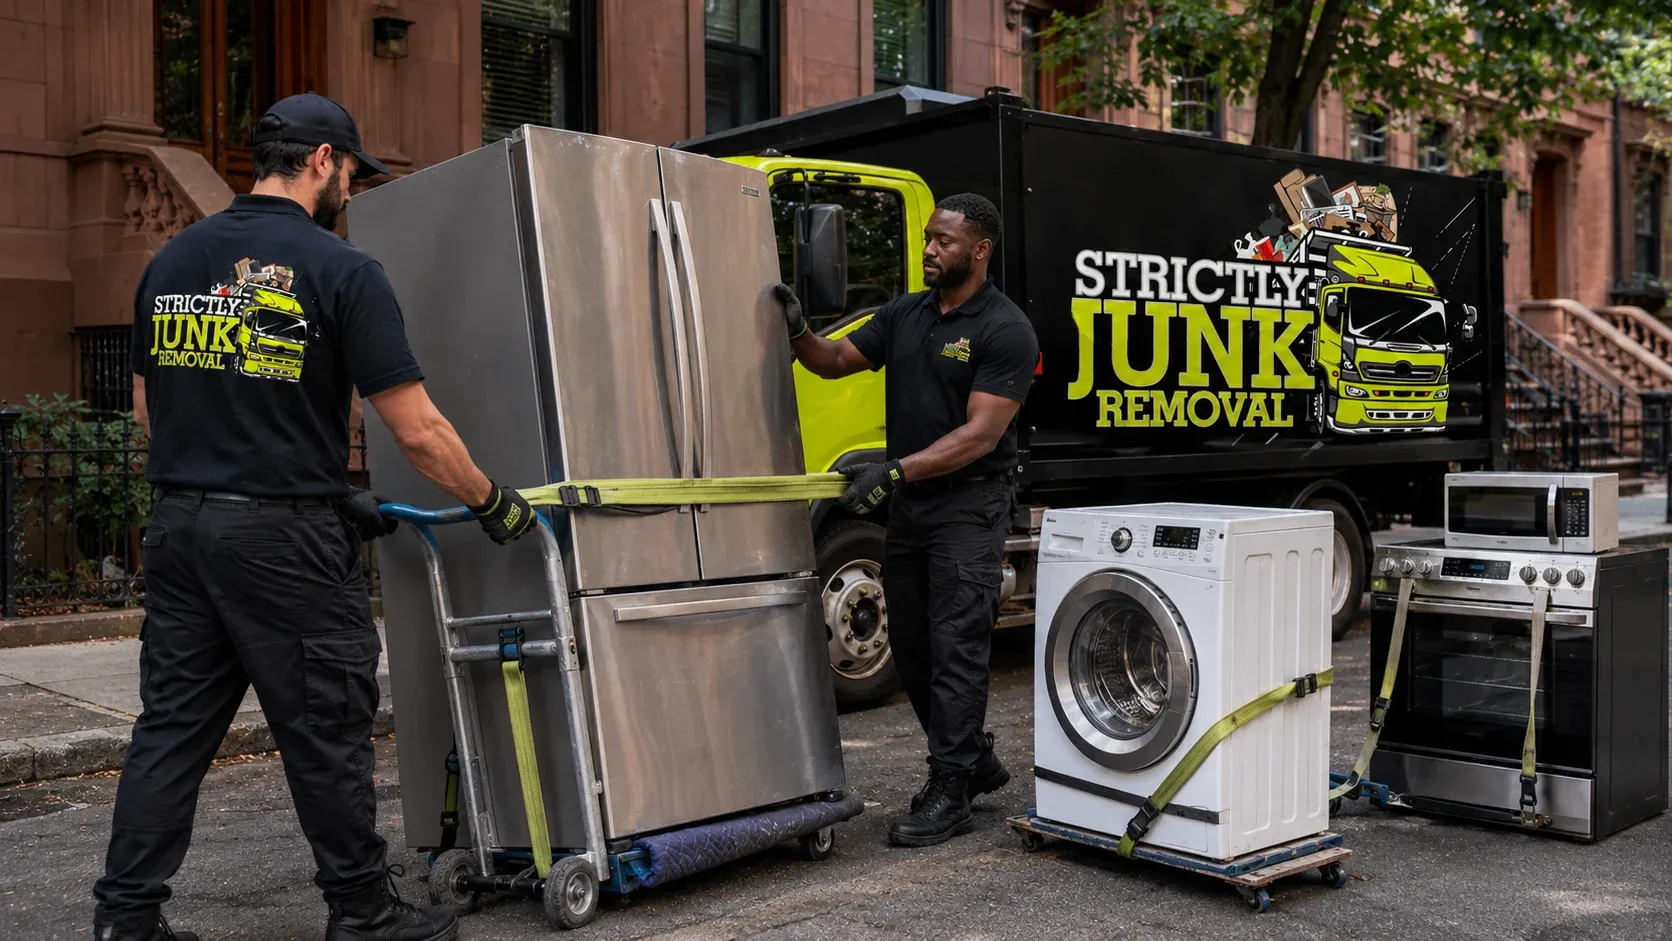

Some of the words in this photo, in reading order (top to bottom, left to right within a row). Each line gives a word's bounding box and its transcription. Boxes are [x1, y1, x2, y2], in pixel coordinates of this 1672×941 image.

[1075, 249, 1309, 308] STRICTLY
[154, 295, 241, 315] STRICTLY
[151, 314, 240, 355] JUNK
[1068, 298, 1315, 400] JUNK
[158, 351, 225, 370] REMOVAL
[1096, 391, 1293, 427] REMOVAL
